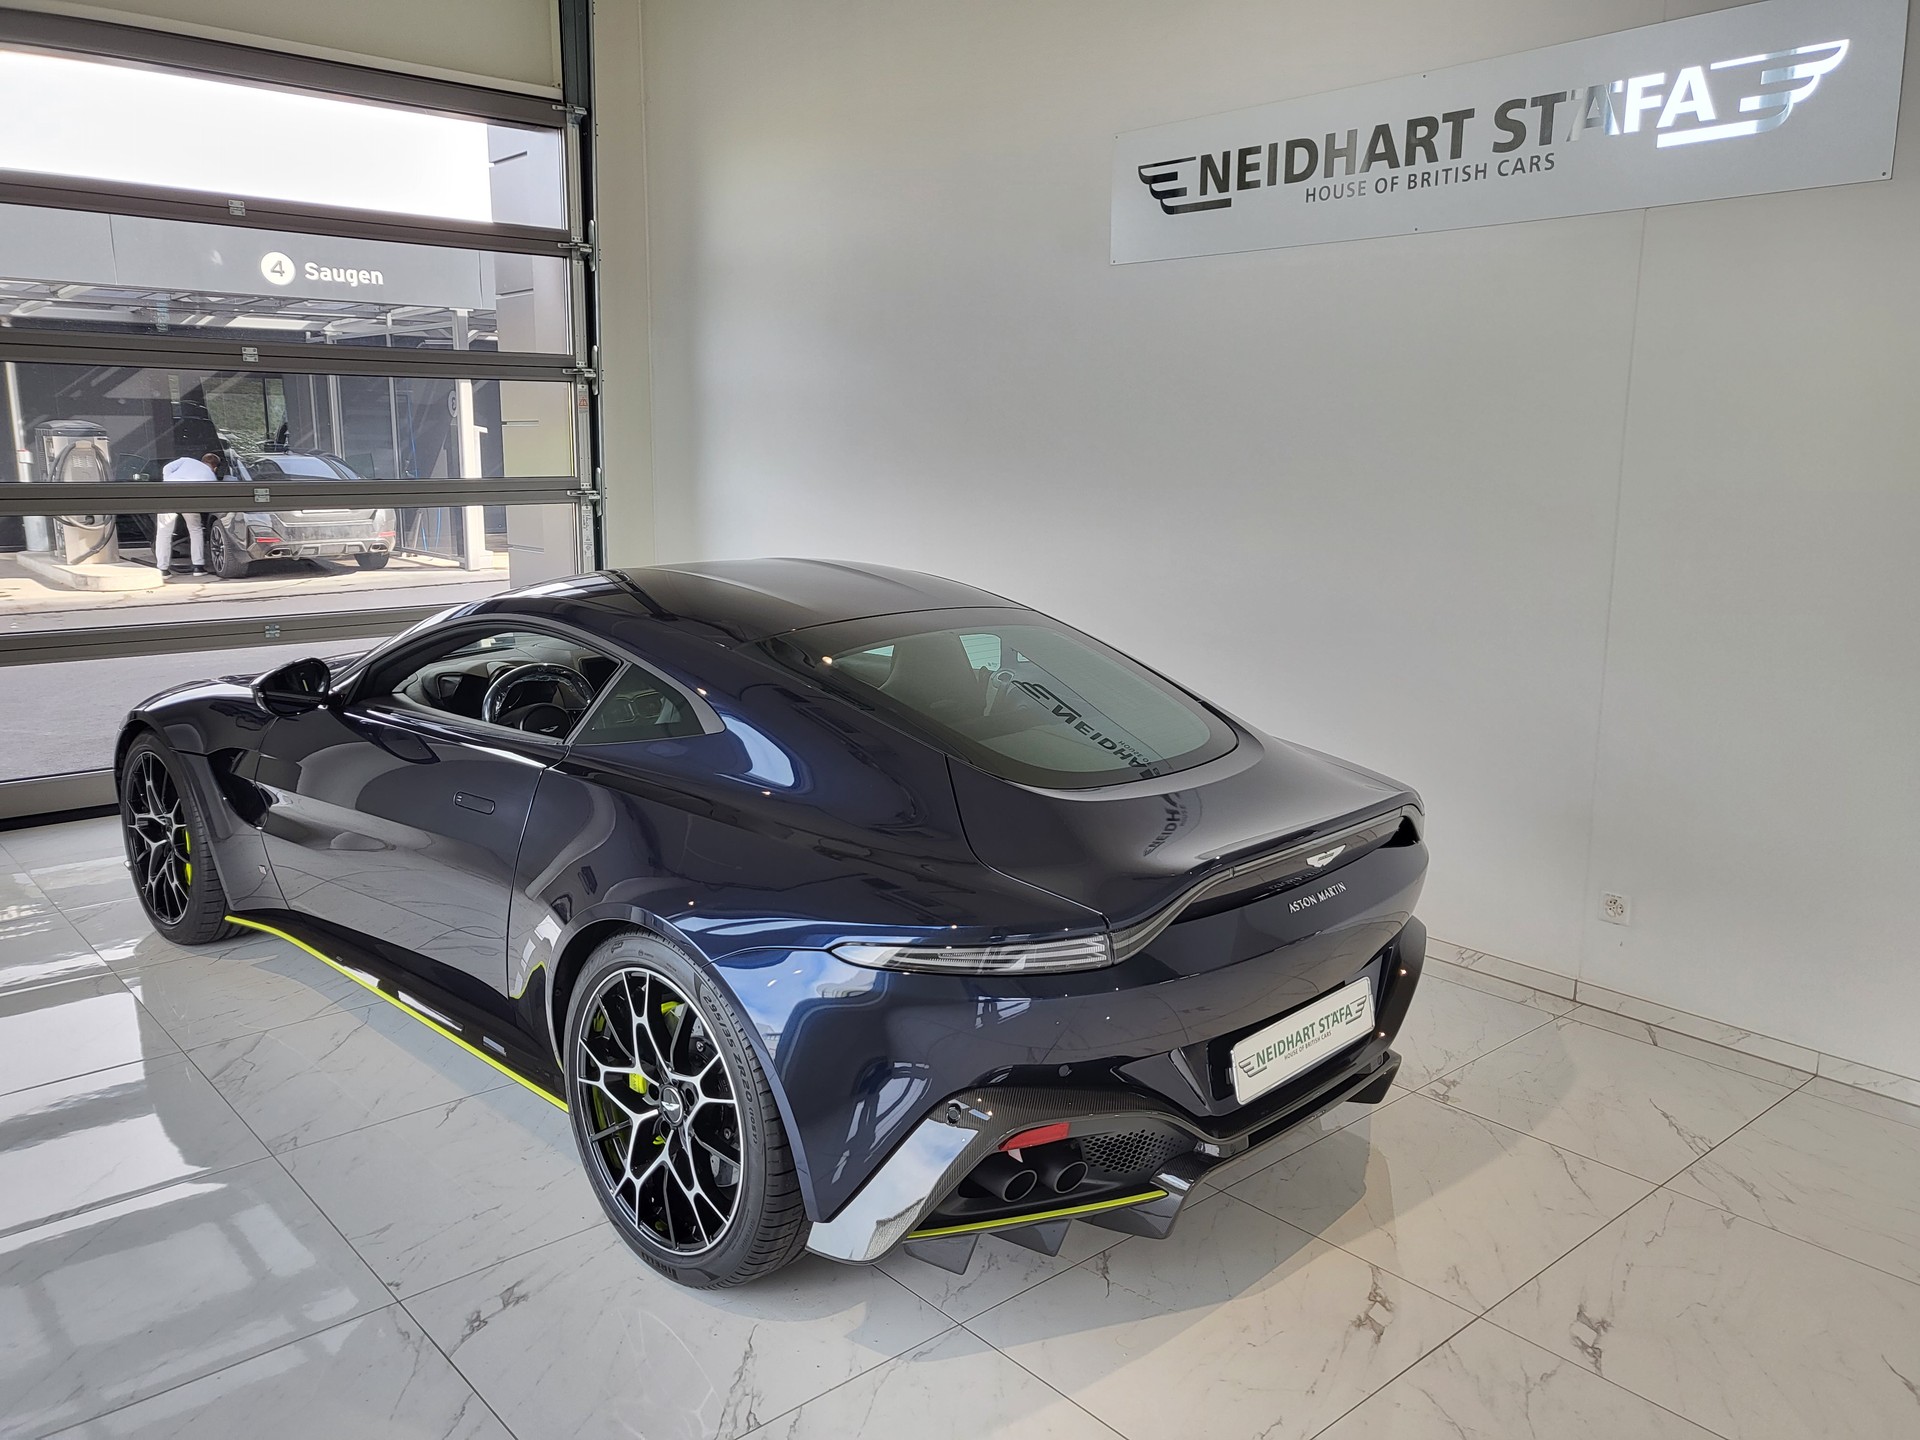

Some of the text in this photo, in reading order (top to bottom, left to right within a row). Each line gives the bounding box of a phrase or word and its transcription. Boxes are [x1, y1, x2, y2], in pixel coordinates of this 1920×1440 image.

[1199, 65, 1716, 197] NEIDHART STÄFA
[1305, 152, 1556, 204] HOUSE OF BRITISH CARS
[270, 259, 384, 288] 4 Saugen
[1287, 881, 1348, 914] ASTON MARTIN
[702, 995, 737, 1049] 295/35
[723, 1052, 753, 1104] ZR20
[1256, 1004, 1354, 1068] NEIDHART STÄFA
[1284, 1048, 1299, 1060] HOUSE
[1304, 1035, 1321, 1049] BRITISH
[1320, 1030, 1332, 1041] CARS
